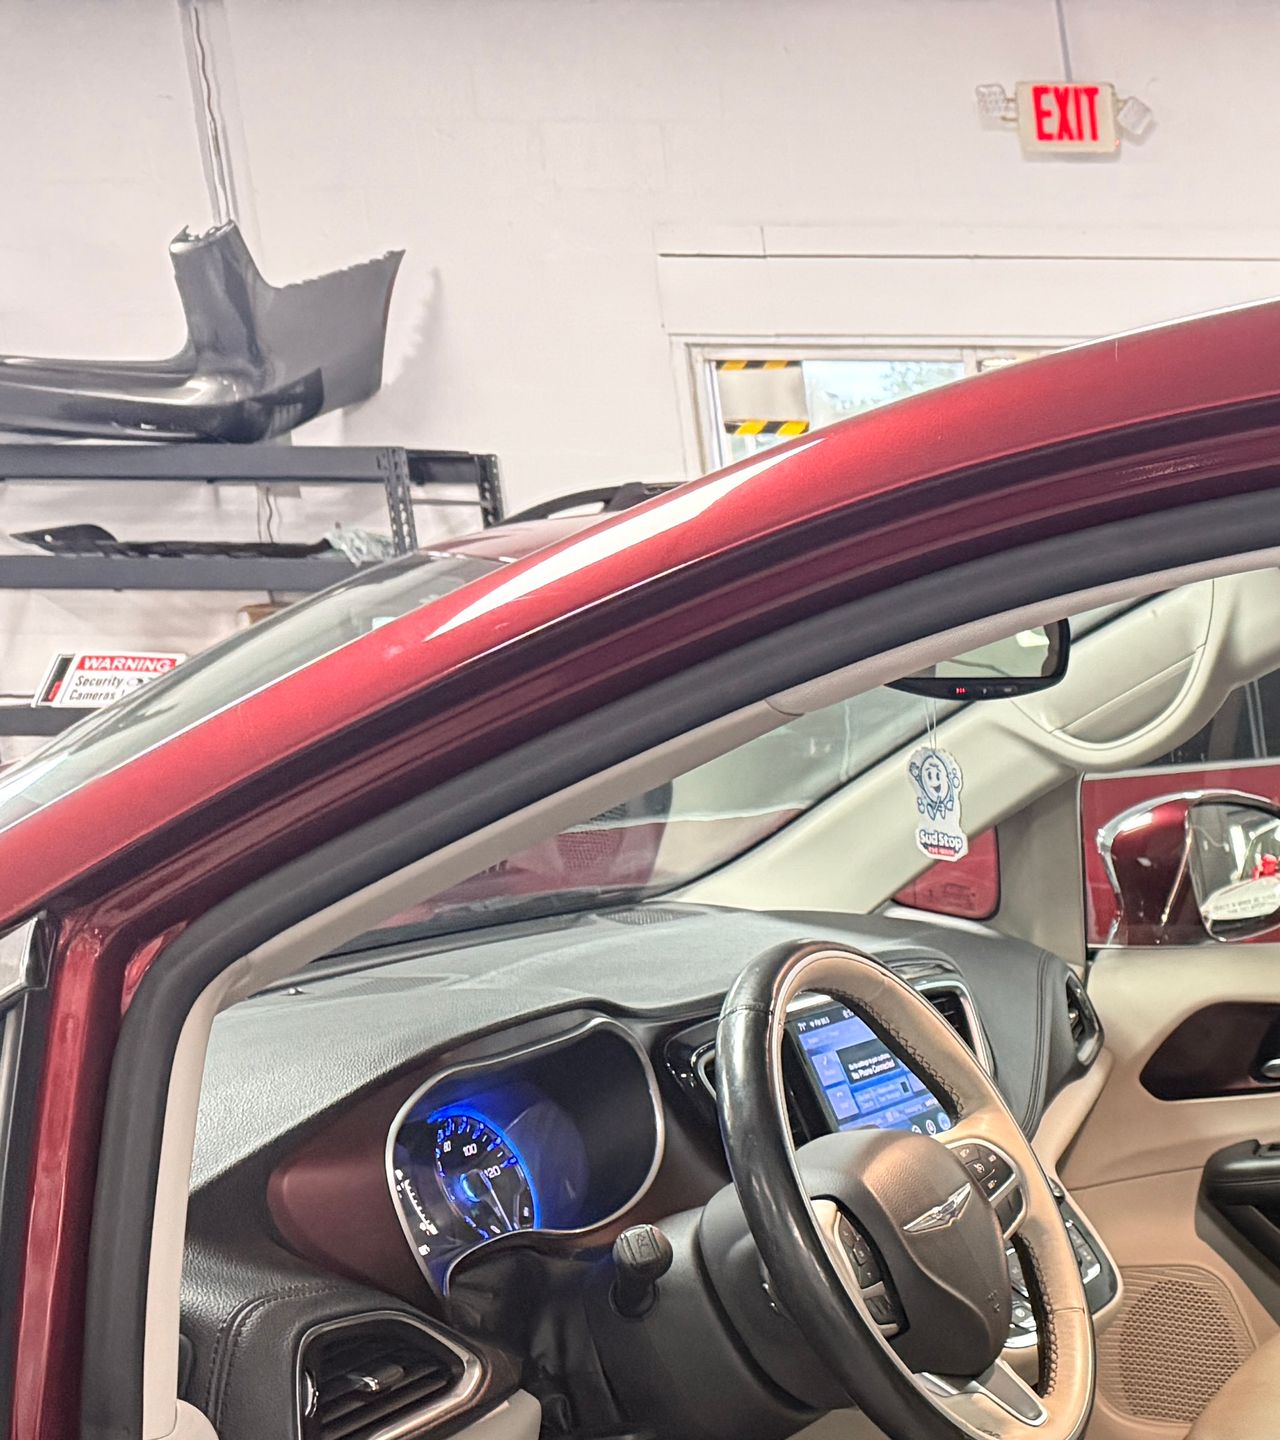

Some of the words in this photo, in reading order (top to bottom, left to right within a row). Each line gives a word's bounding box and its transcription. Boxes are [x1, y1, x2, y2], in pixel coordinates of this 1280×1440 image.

[1032, 85, 1100, 142] EXIT
[84, 657, 171, 671] WARNING
[75, 675, 124, 689] Security
[69, 689, 115, 701] Cameras
[463, 1143, 477, 1156] 100
[484, 1165, 501, 1178] 120
